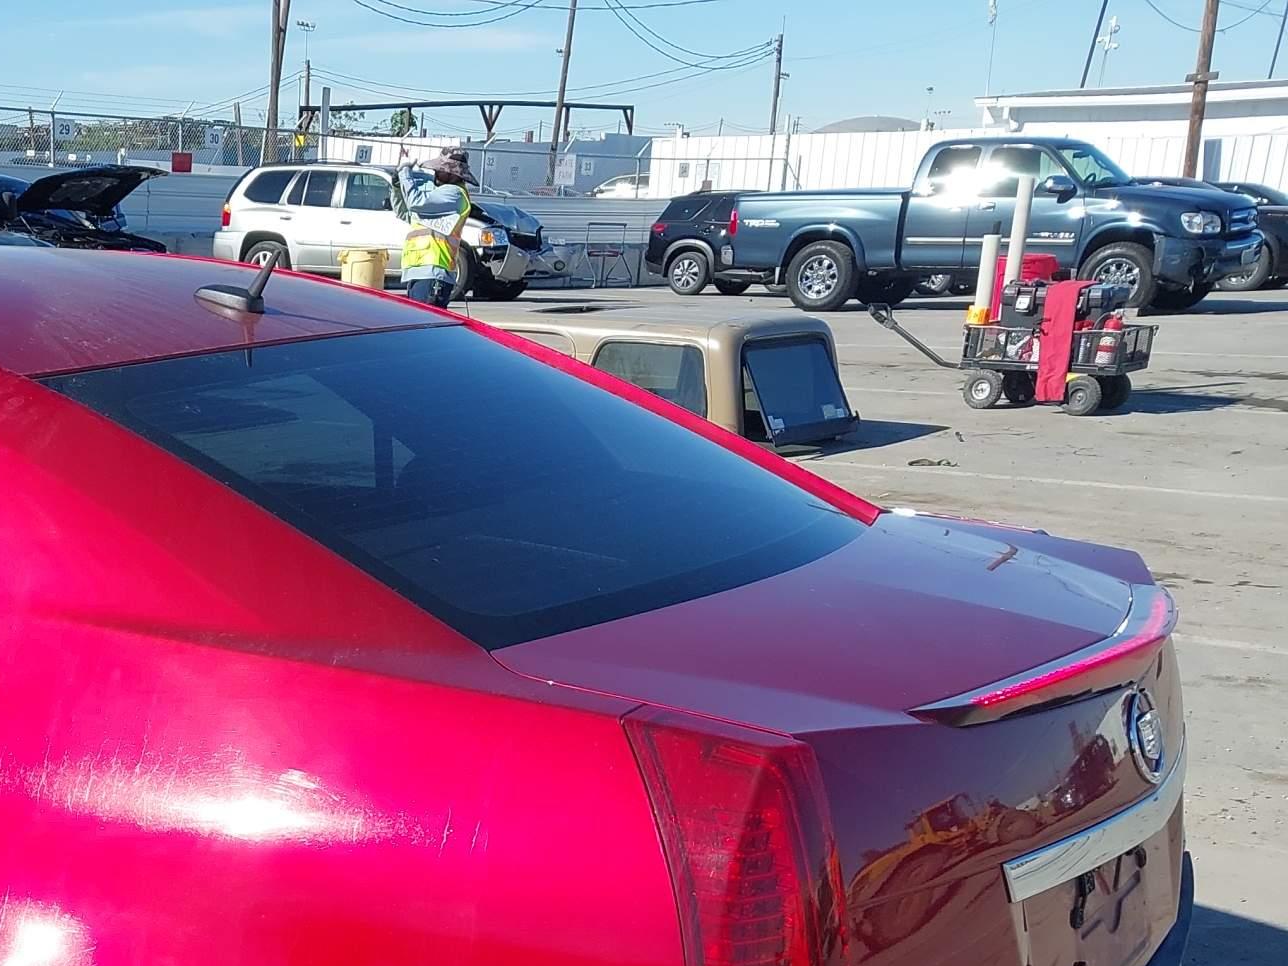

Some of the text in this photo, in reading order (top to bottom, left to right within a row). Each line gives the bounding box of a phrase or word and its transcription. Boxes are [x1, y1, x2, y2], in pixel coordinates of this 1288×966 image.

[59, 123, 71, 136] 29
[209, 132, 220, 145] 30
[359, 149, 369, 160] 31
